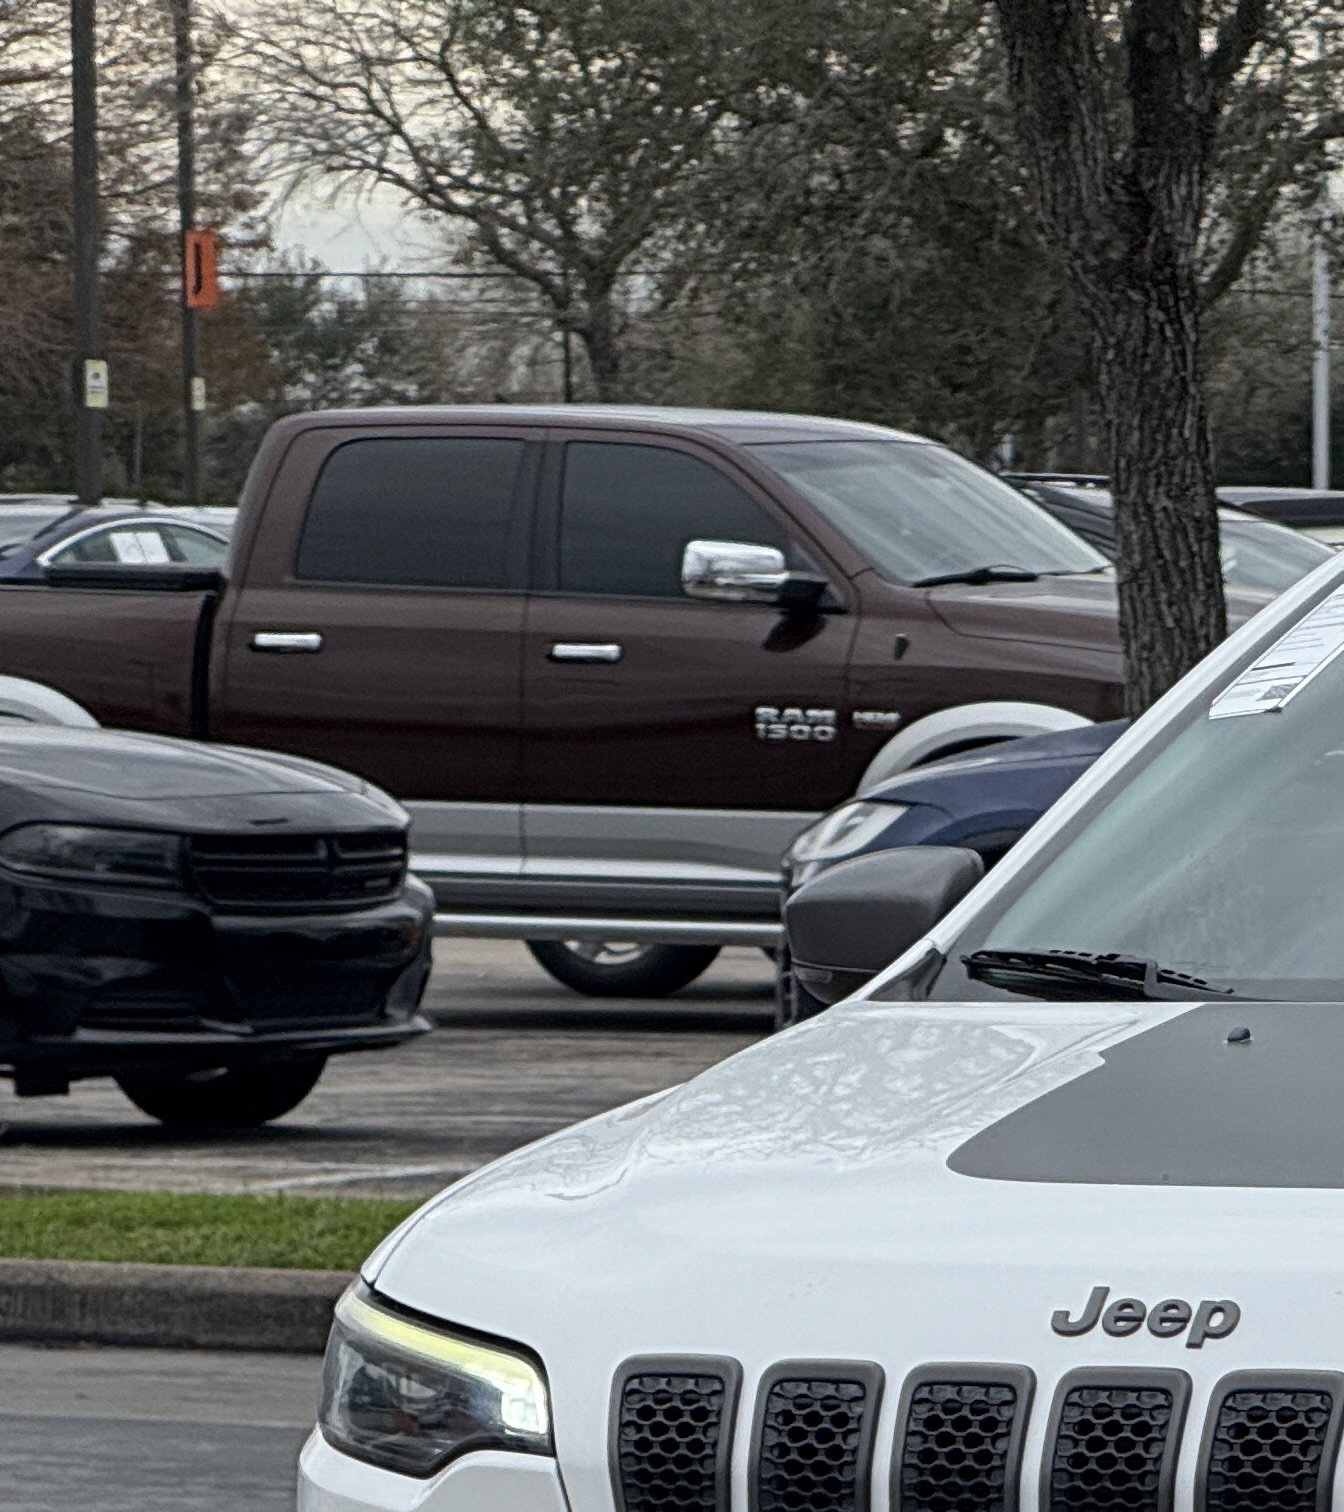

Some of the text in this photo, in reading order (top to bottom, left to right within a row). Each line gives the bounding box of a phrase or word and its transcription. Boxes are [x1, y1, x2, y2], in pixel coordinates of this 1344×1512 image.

[754, 706, 837, 724] RAM
[754, 723, 838, 742] 1500
[1051, 1286, 1241, 1349] Jeep
